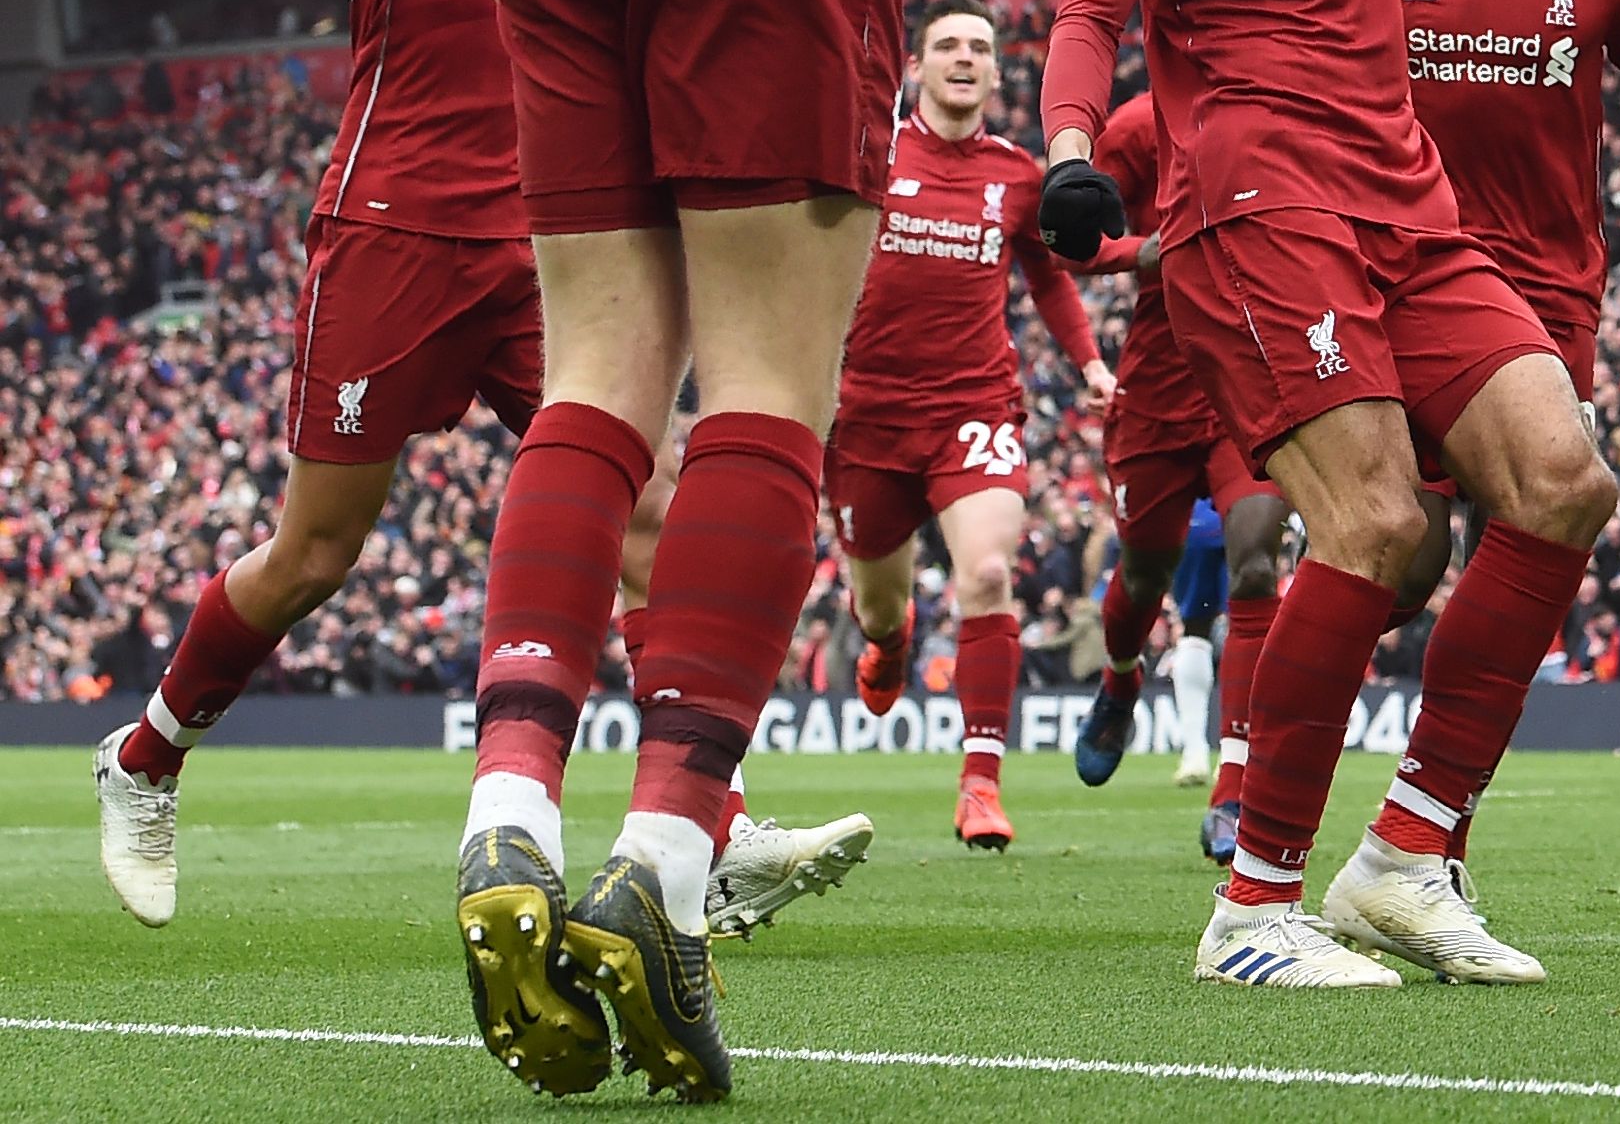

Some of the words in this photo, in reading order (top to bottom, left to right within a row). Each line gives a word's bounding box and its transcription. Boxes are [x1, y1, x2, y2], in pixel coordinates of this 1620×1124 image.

[1408, 27, 1541, 57] Standard
[1407, 56, 1538, 85] Chartered
[887, 211, 981, 241] Standard
[880, 231, 979, 261] Chartered
[957, 420, 1021, 469] 26
[750, 696, 965, 754] GAPOR
